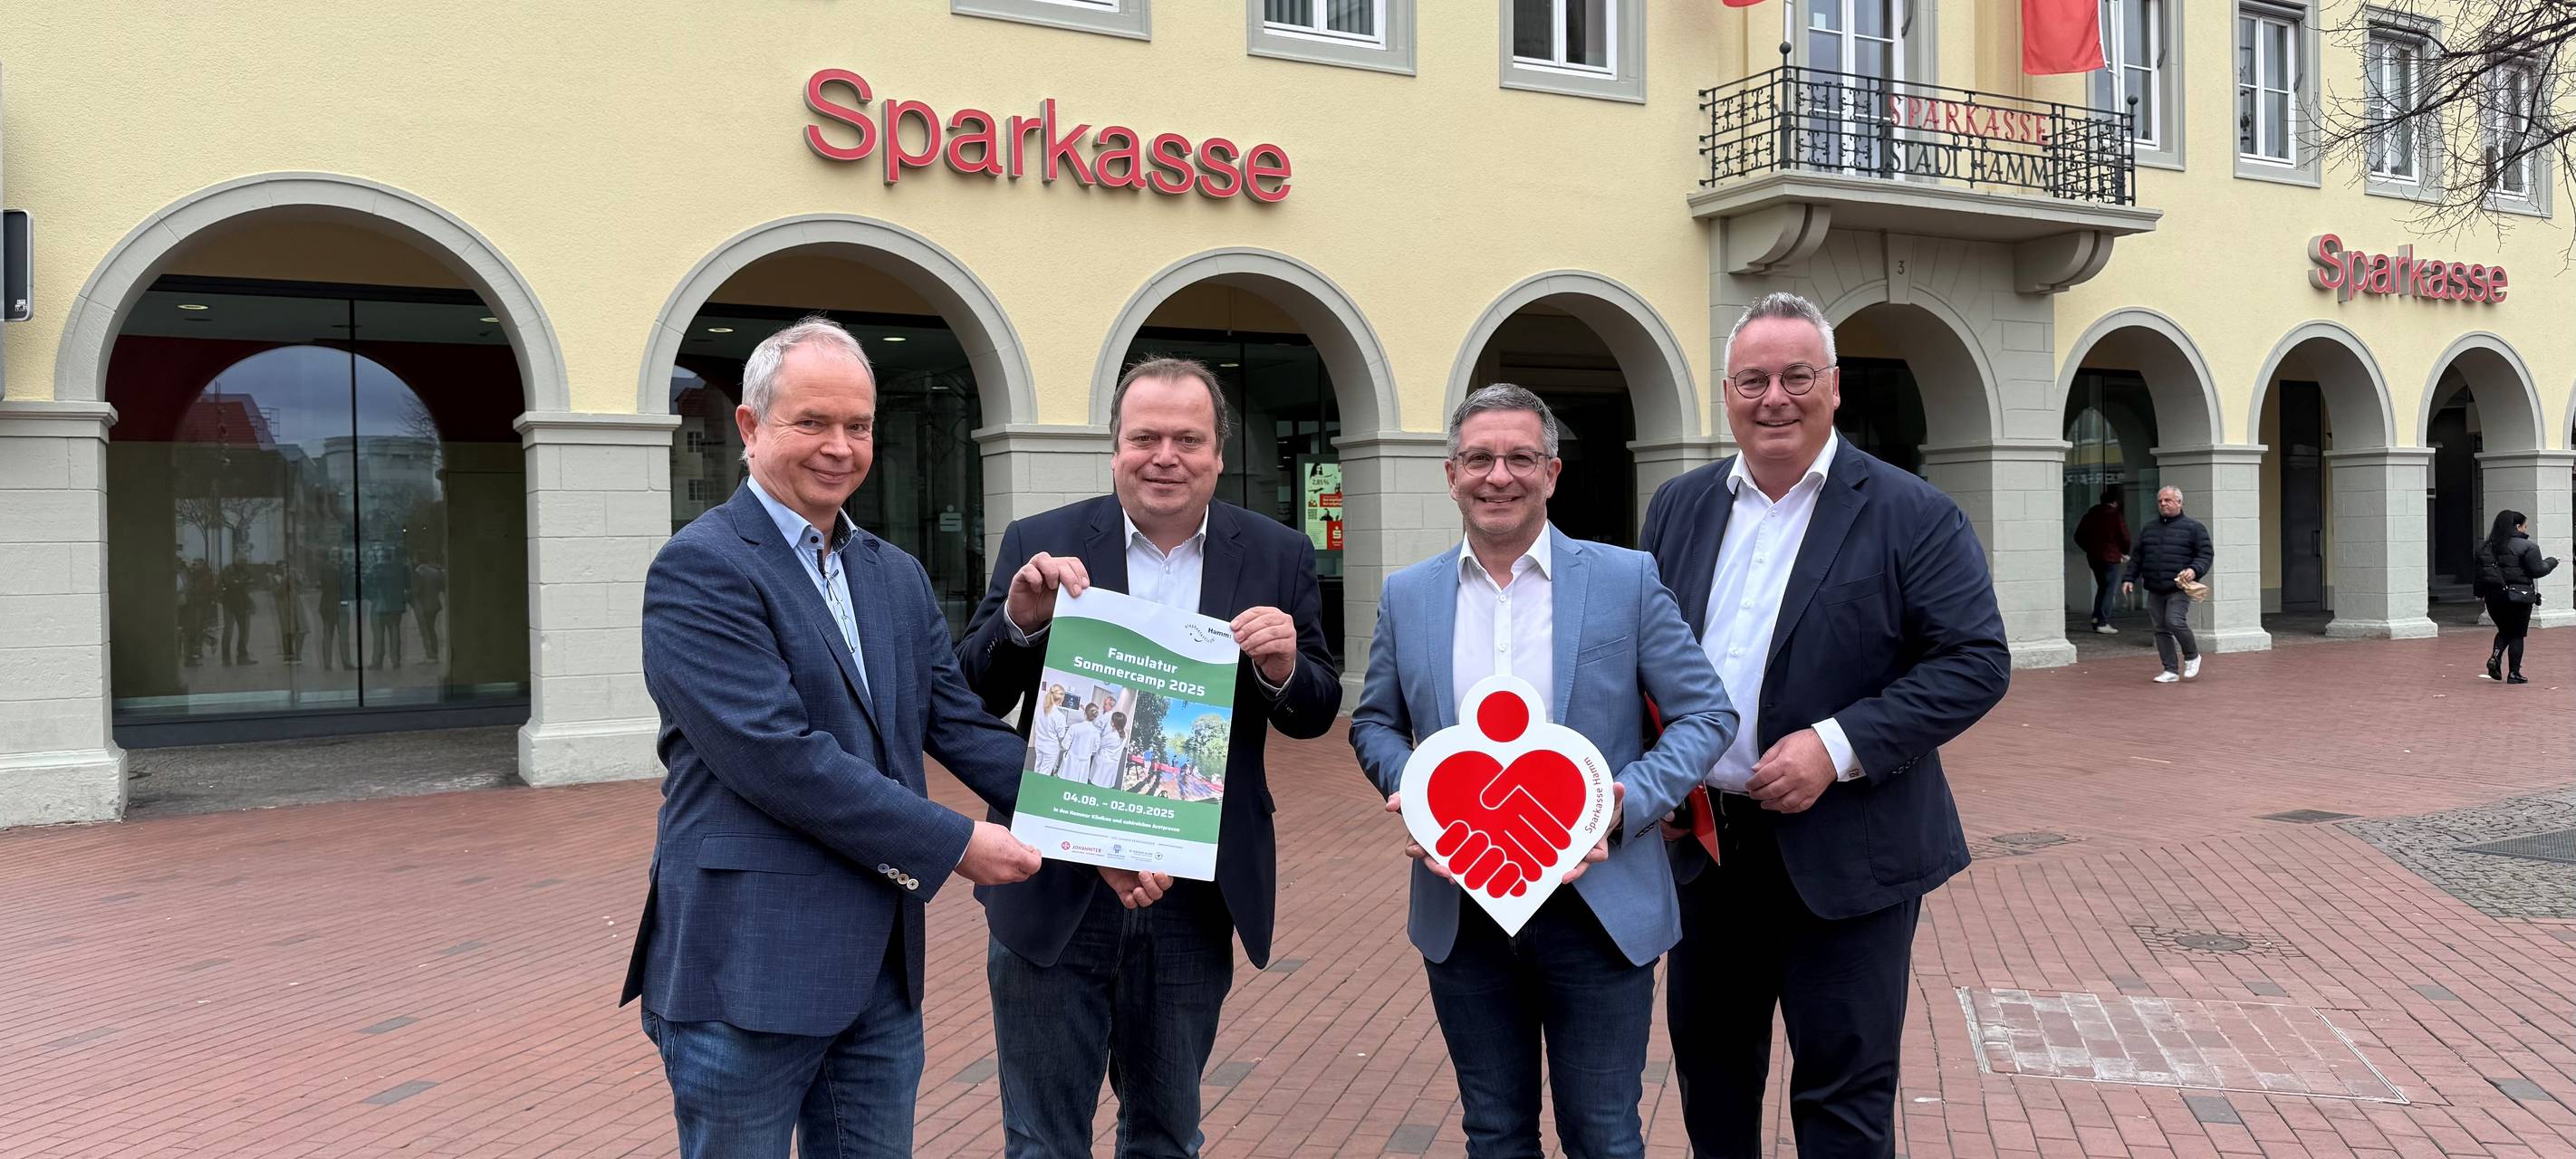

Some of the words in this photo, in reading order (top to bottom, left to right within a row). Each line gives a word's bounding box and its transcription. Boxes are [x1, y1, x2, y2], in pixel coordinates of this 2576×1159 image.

[803, 69, 1293, 204] Sparkasse
[1889, 94, 2049, 146] SPARKASSE
[1952, 133, 1991, 150] DER
[1888, 140, 1962, 178] STADT
[1970, 148, 2050, 191] HAMM
[1898, 260, 1906, 275] 3
[2309, 234, 2508, 303] Sparkasse
[1073, 656, 1166, 689] Sommercamp
[1168, 679, 1206, 696] 2025
[1108, 647, 1177, 674] Famulatur
[1584, 756, 1601, 785] Hamm
[1063, 791, 1100, 807] 04.08.
[1110, 800, 1175, 819] 02.09.2025
[1584, 788, 1603, 834] Sparkasse
